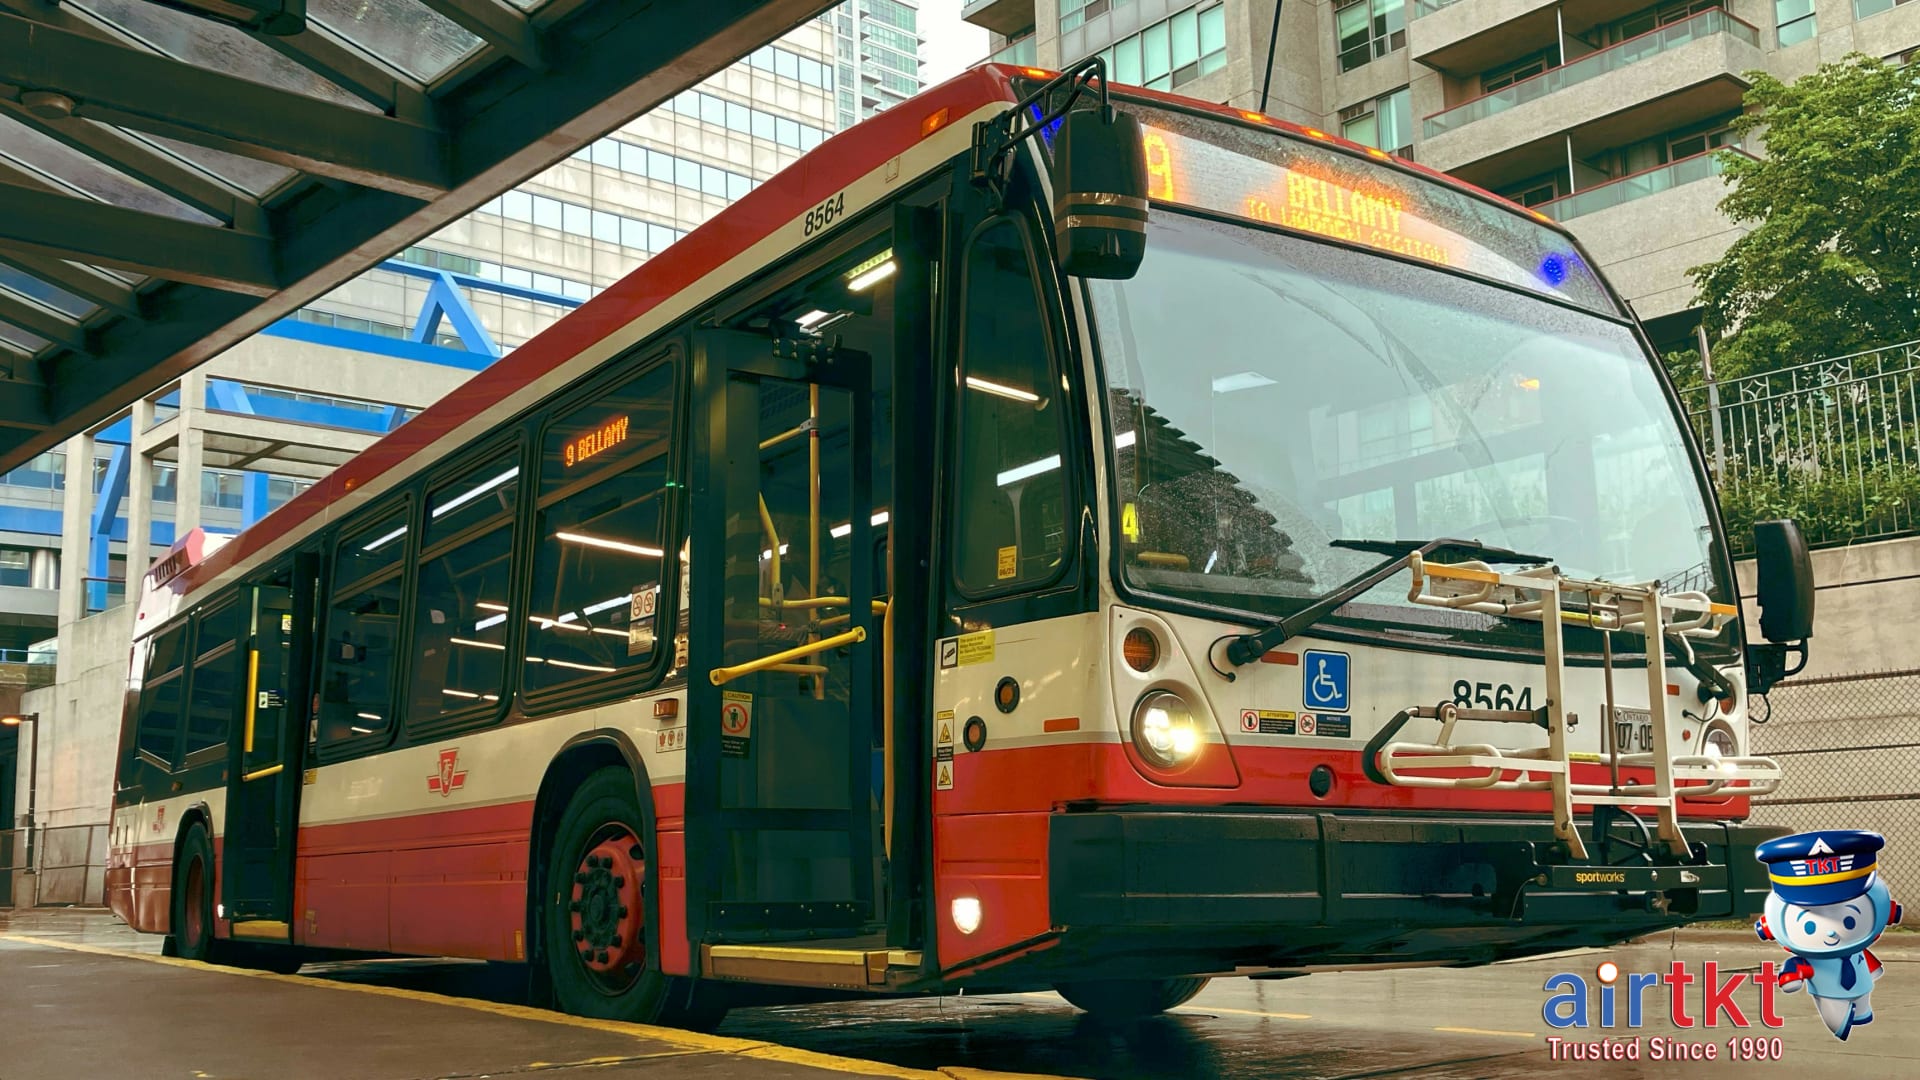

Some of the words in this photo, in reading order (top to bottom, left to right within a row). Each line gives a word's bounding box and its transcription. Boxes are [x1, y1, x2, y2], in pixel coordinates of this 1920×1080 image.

[1144, 133, 1173, 202] 9
[1287, 170, 1401, 233] BELLAMY
[804, 191, 844, 237] 8564
[566, 444, 574, 467] 9
[578, 416, 628, 461] BELLAMY
[1122, 503, 1138, 543] 4
[1453, 679, 1531, 711] 8564
[1623, 710, 1649, 722] ONTARIO
[1575, 871, 1625, 884] sportworks
